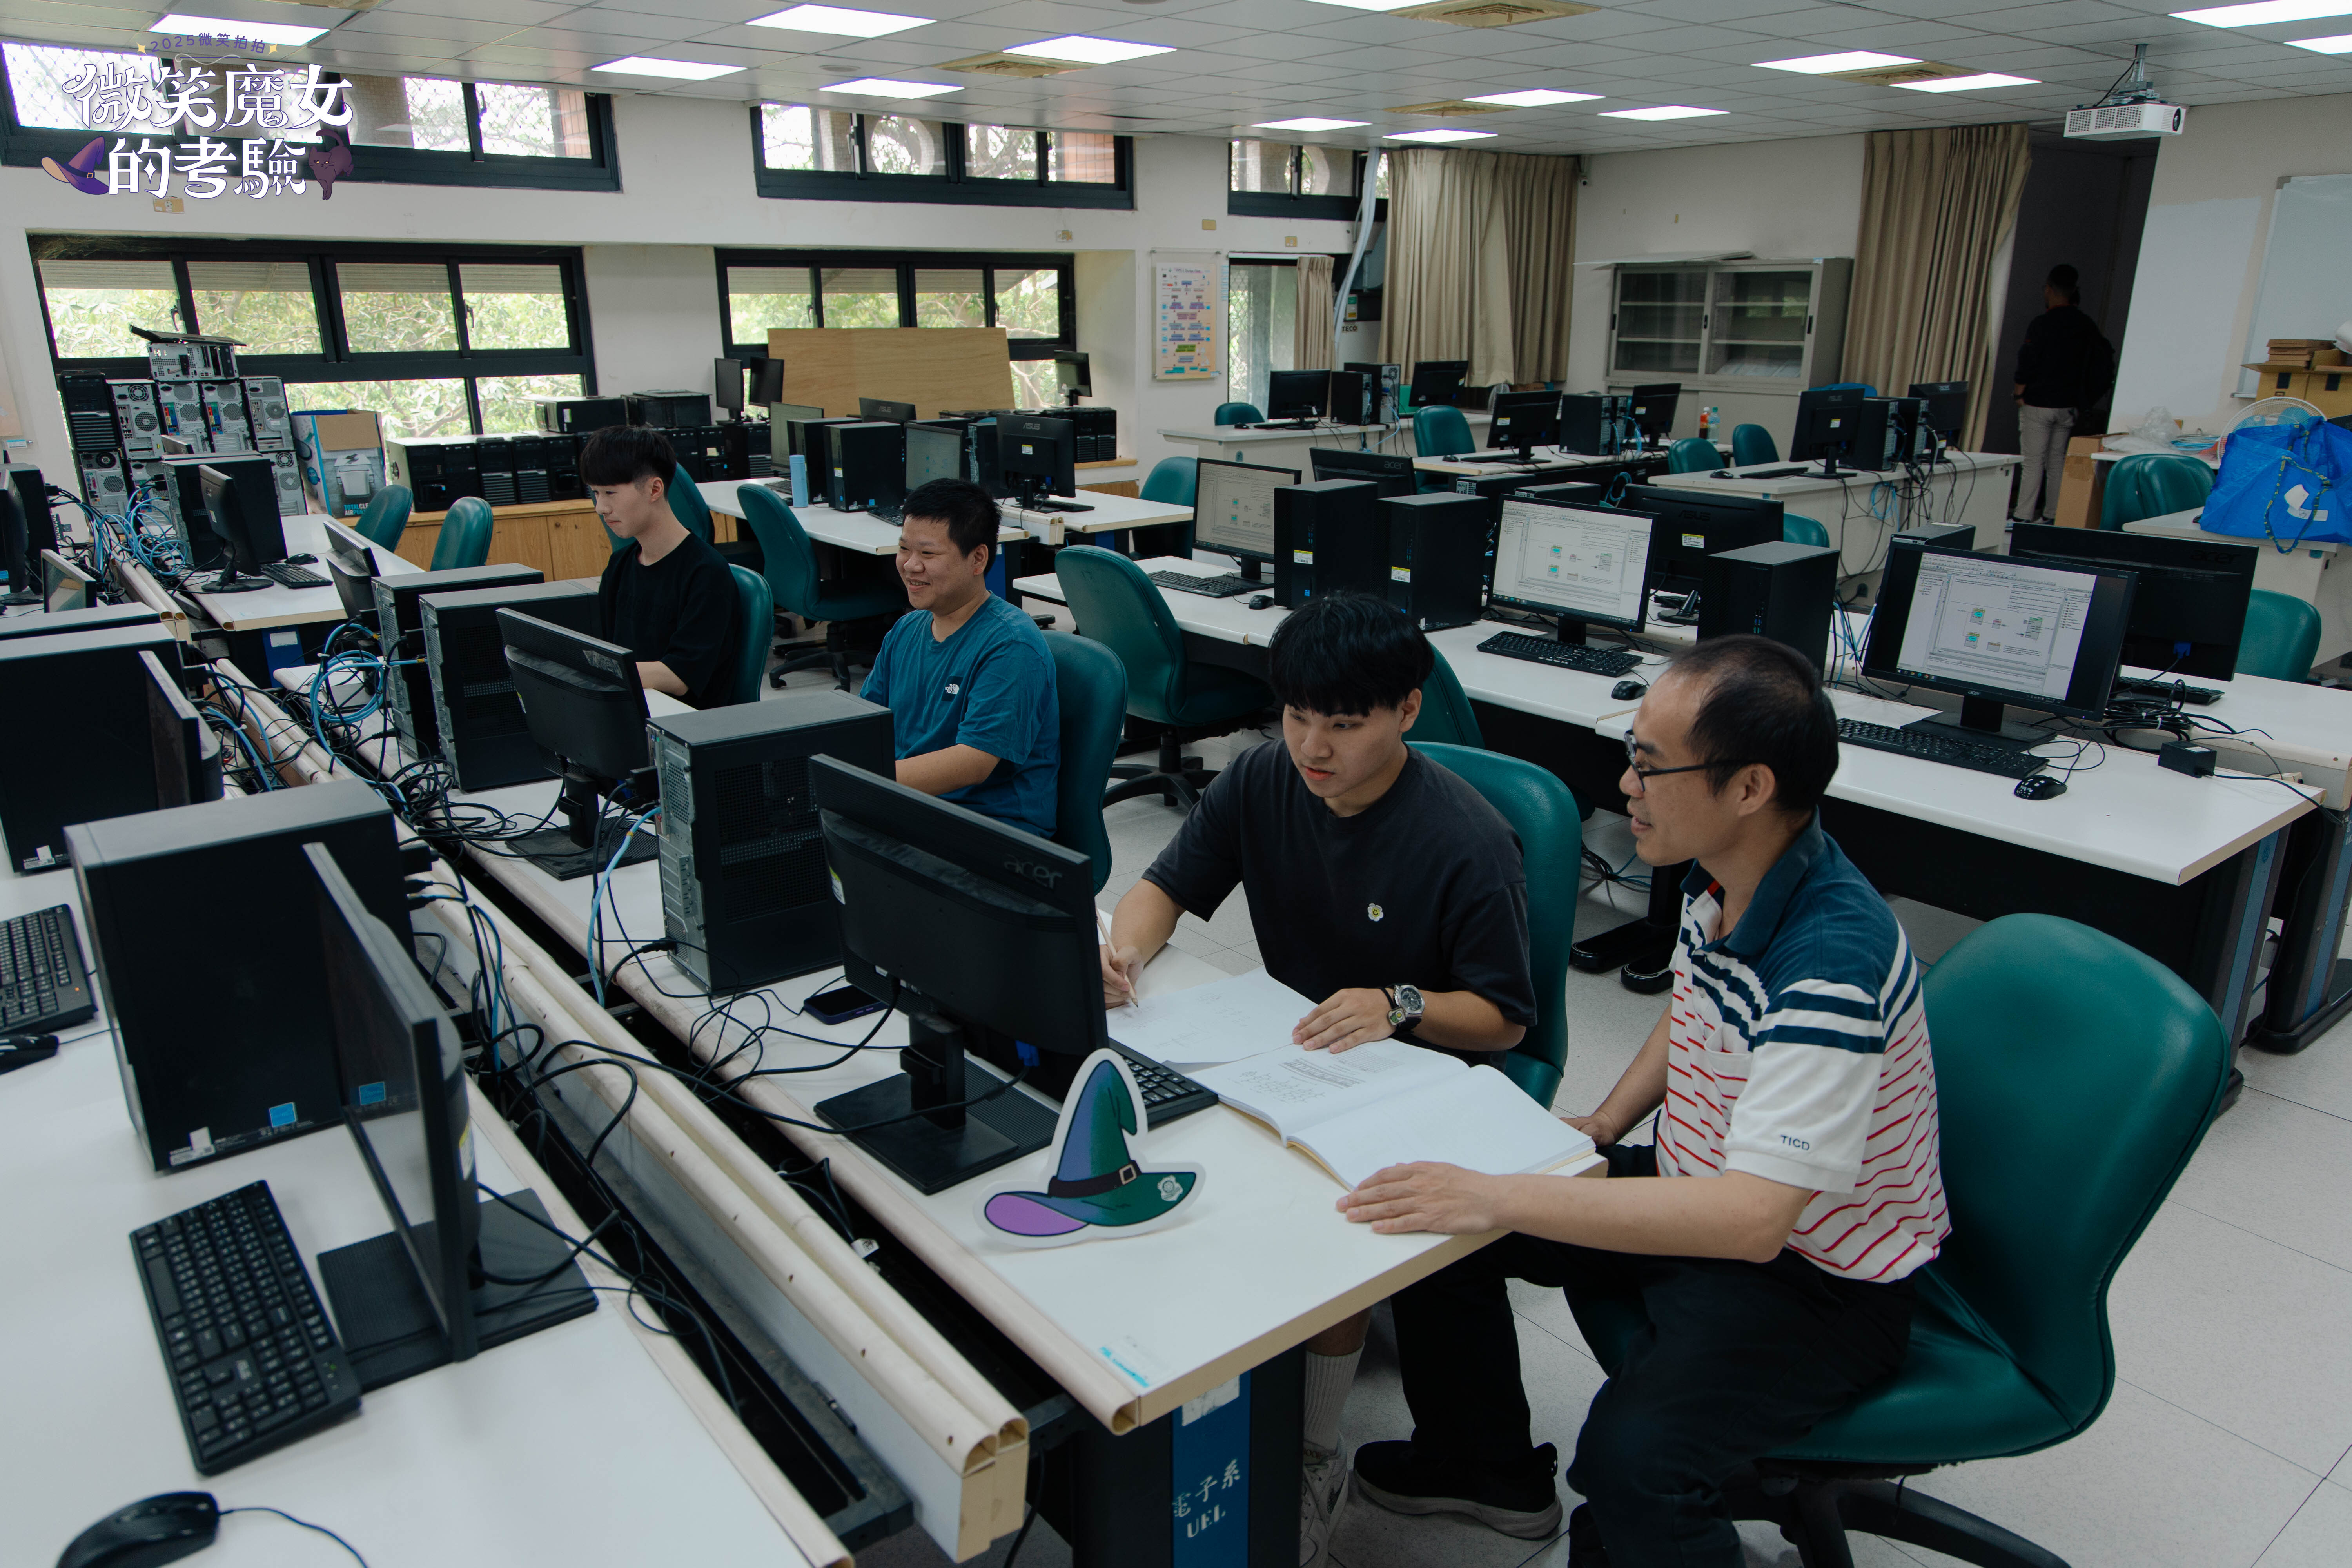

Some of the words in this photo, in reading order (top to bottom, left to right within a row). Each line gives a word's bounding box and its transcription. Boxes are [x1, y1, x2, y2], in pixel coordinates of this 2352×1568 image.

[1384, 461, 1404, 469] acer
[1678, 510, 1711, 521] ASUS
[2190, 549, 2242, 565] acer
[1004, 853, 1063, 889] acer
[1780, 1135, 1810, 1151] TICD
